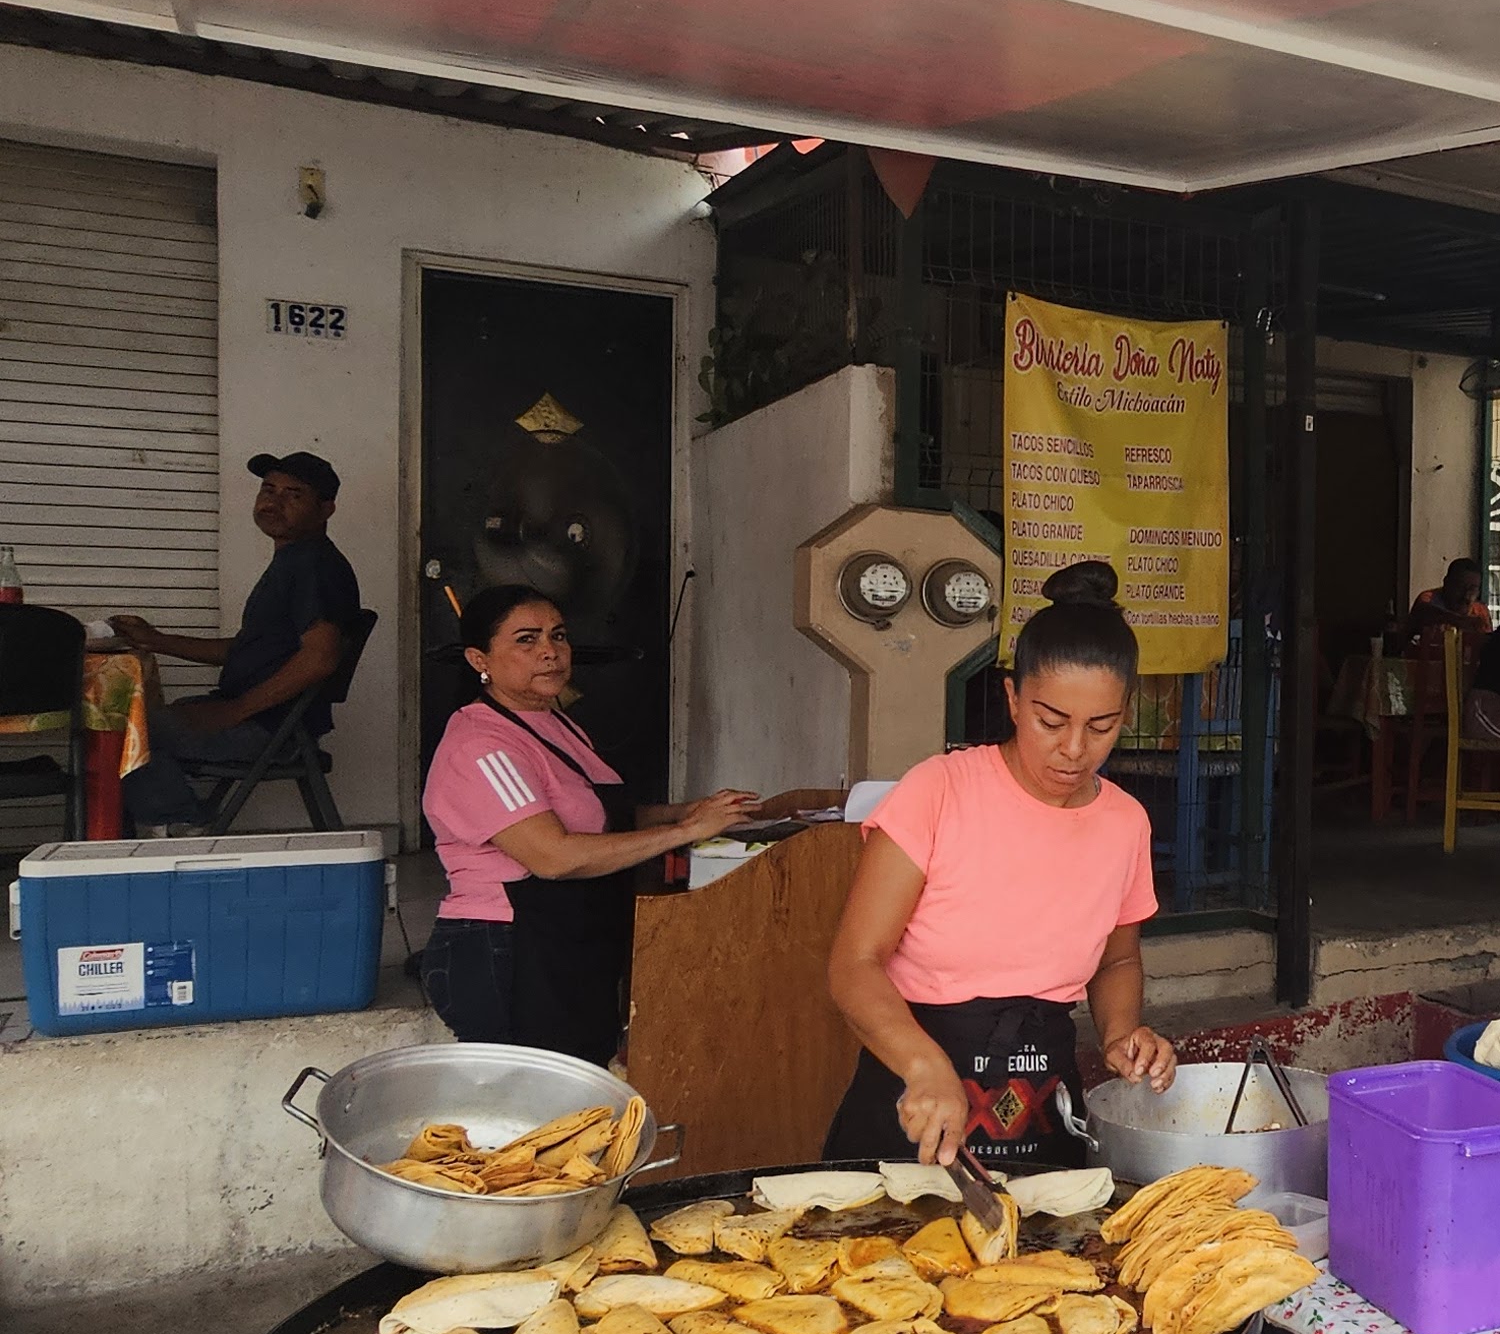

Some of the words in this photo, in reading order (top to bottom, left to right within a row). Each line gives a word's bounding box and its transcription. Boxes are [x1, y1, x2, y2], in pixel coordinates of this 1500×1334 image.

[270, 302, 345, 331] 1622
[1168, 338, 1222, 395] Naty
[1057, 381, 1092, 407] Estilo
[1095, 388, 1186, 413] Michoacán
[1011, 433, 1044, 452] TACOS
[1046, 437, 1095, 458] SENCILLOS
[1124, 447, 1172, 464] REFRESCO
[1011, 463, 1043, 481] TACOS
[1045, 465, 1067, 482] CON
[1069, 468, 1100, 485] QUESO
[1011, 491, 1041, 509] PLATO
[1043, 494, 1074, 512] CHICO
[1011, 520, 1040, 538] PLATO
[1042, 523, 1083, 541] GRANDE
[1129, 528, 1180, 546] DOMINGOS
[1181, 530, 1223, 547] MENUDO
[1012, 548, 1067, 567] QUESADILLA
[1127, 556, 1153, 572] PLATO
[1155, 557, 1179, 573] CHICO
[1126, 584, 1151, 600] PLATO
[1152, 585, 1185, 601] GRANDE
[78, 961, 124, 977] CHILLER
[1008, 1054, 1048, 1072] EQUIS
